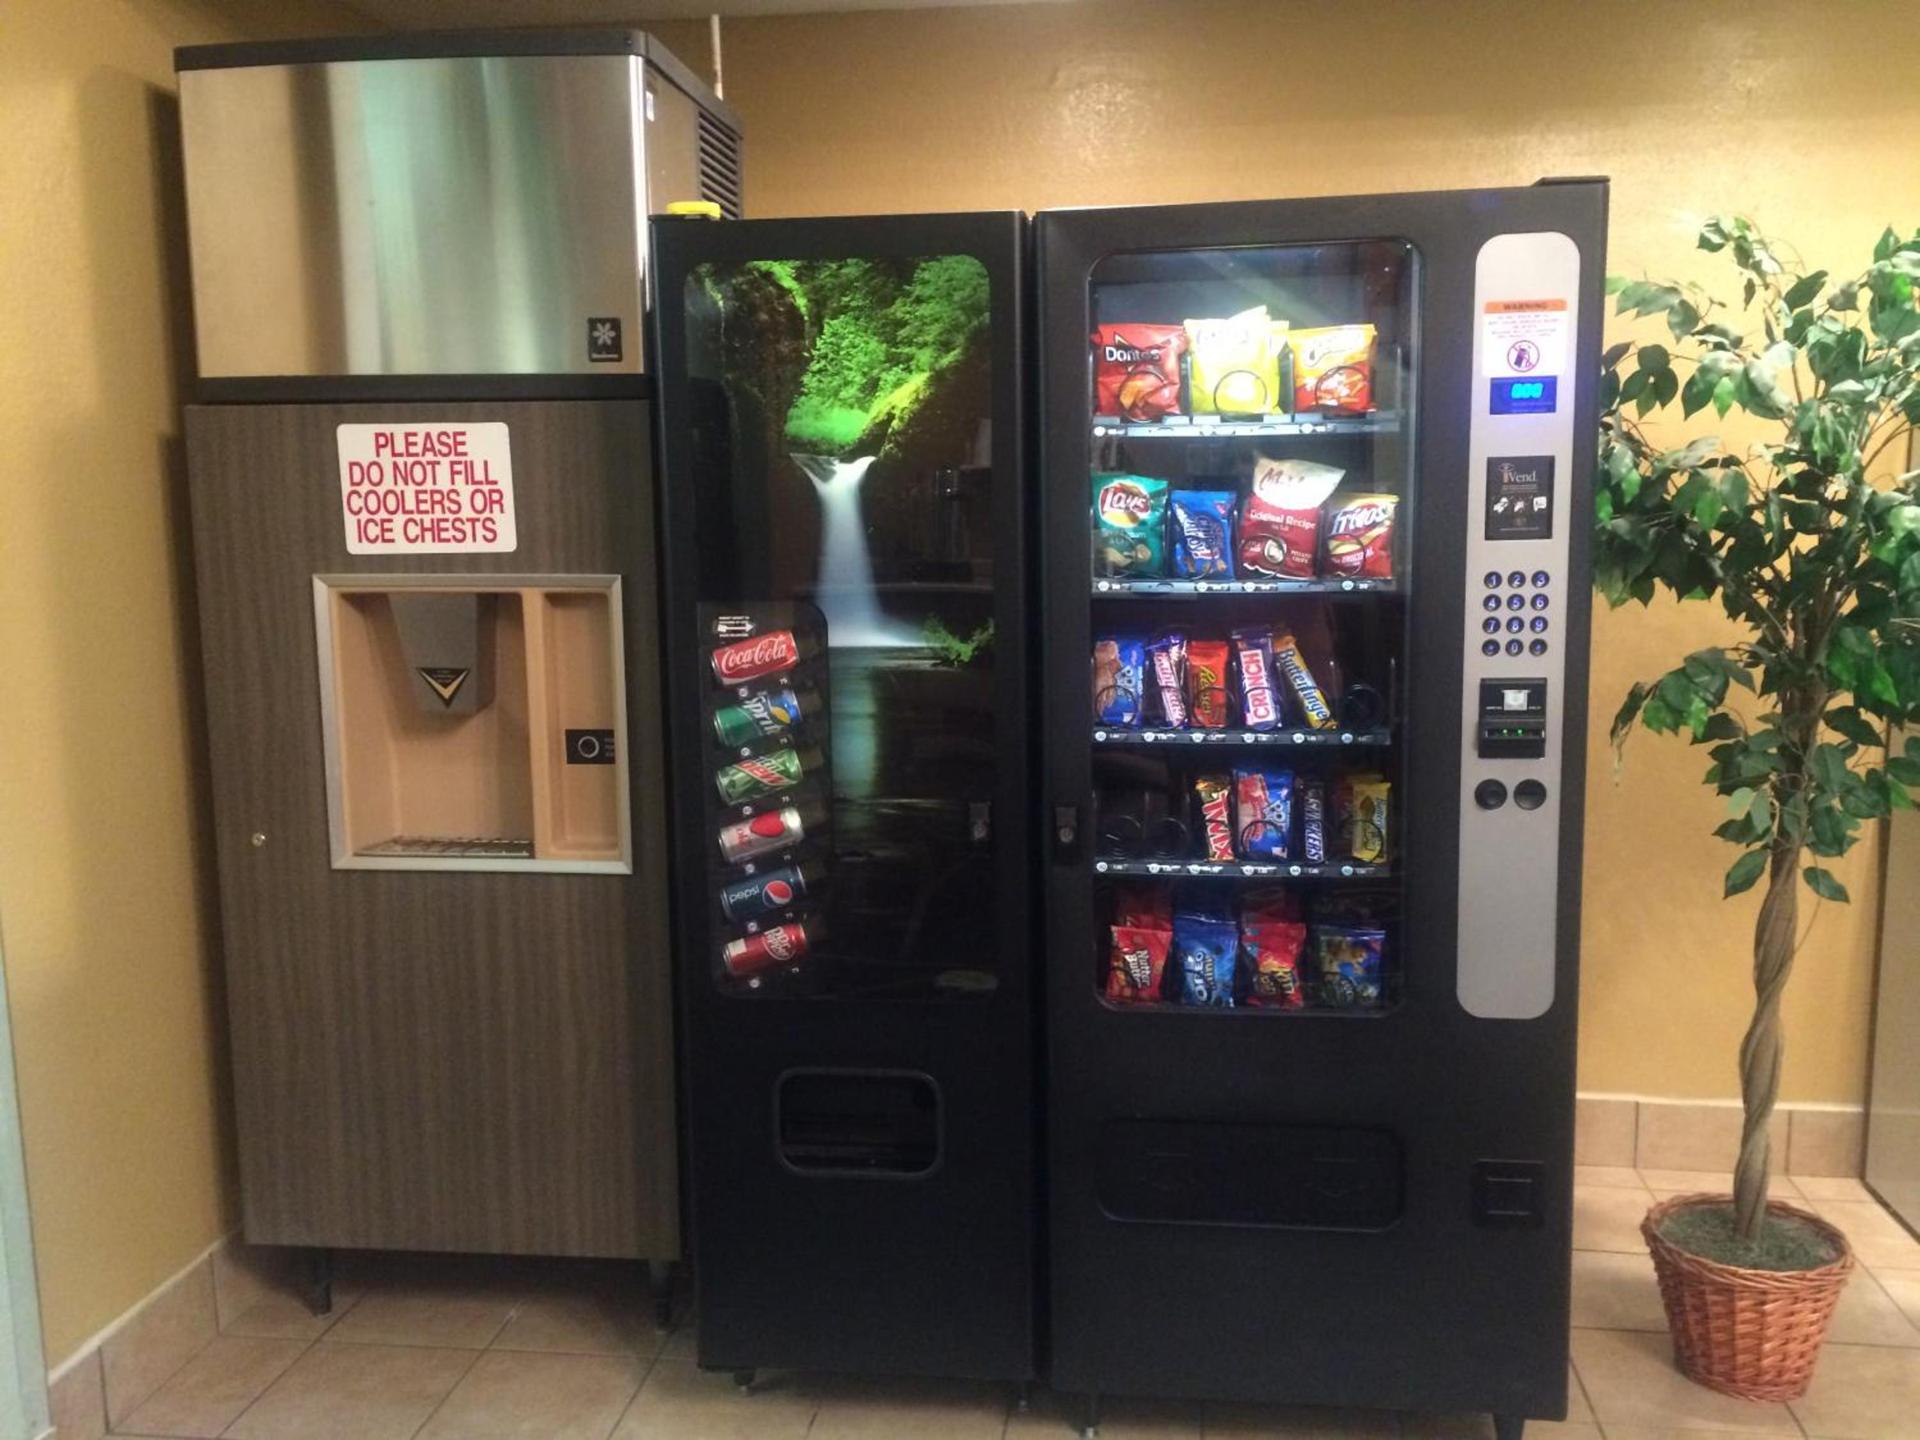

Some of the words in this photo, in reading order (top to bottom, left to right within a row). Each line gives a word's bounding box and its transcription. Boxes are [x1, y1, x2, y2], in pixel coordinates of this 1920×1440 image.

[1105, 346, 1161, 362] Doritos
[374, 431, 468, 458] PLEASE
[348, 461, 384, 487] DO
[392, 460, 441, 486] NOT
[449, 460, 498, 486] FILL
[346, 489, 463, 516] COOLERS
[470, 488, 505, 515] OR
[356, 518, 396, 544] ICE
[403, 517, 498, 544] CHESTS
[1243, 653, 1270, 719] CRUNCH
[1280, 649, 1328, 720] Butterfinge
[743, 695, 783, 736] Sprit
[1202, 789, 1235, 860] TWIX
[729, 885, 760, 904] pepsi
